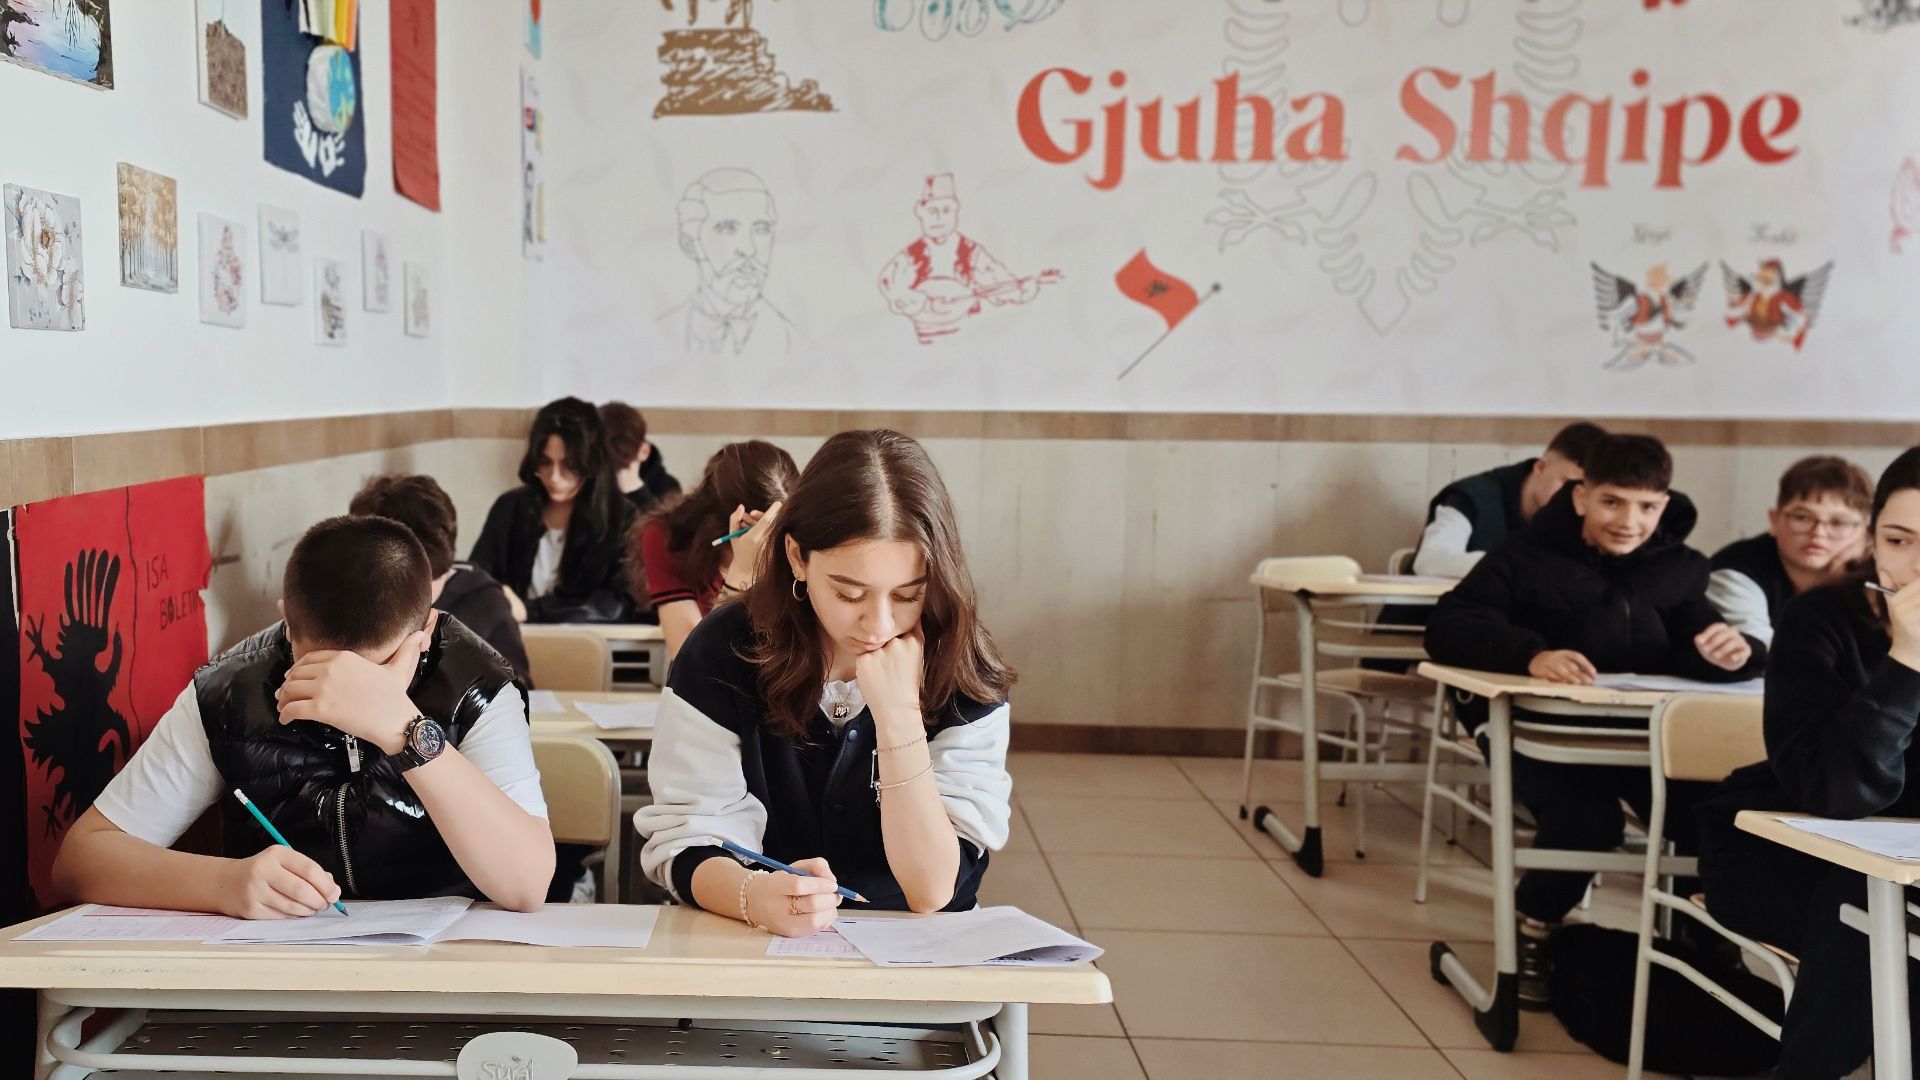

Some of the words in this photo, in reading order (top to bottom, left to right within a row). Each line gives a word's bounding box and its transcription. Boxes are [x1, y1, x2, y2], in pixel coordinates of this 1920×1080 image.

[1017, 67, 1348, 191] Gjuha
[1395, 67, 1802, 189] Shqipe
[146, 554, 169, 592] ISA
